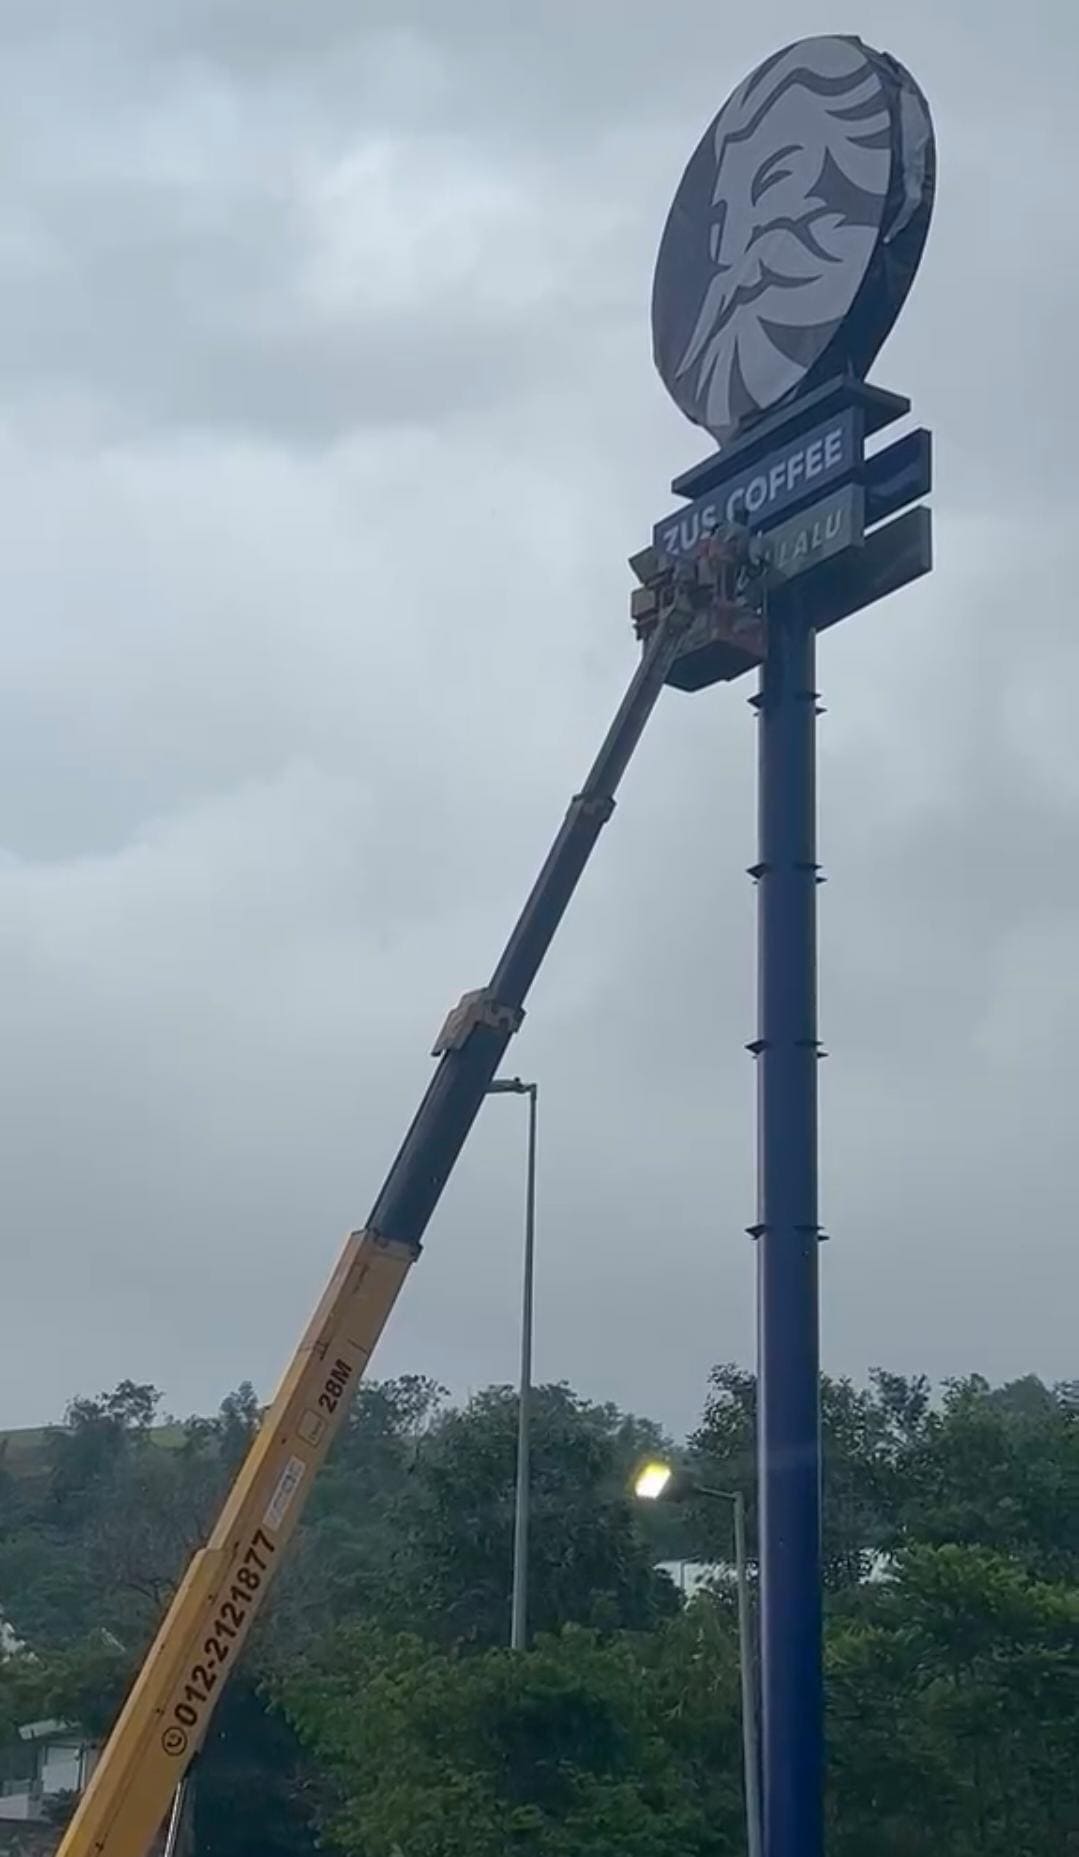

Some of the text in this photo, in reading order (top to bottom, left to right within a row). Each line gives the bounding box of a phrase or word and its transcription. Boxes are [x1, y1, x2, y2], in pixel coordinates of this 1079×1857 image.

[726, 428, 843, 524] COFFEE
[318, 1358, 352, 1414] 28M
[174, 1529, 276, 1729] 012-2121877
